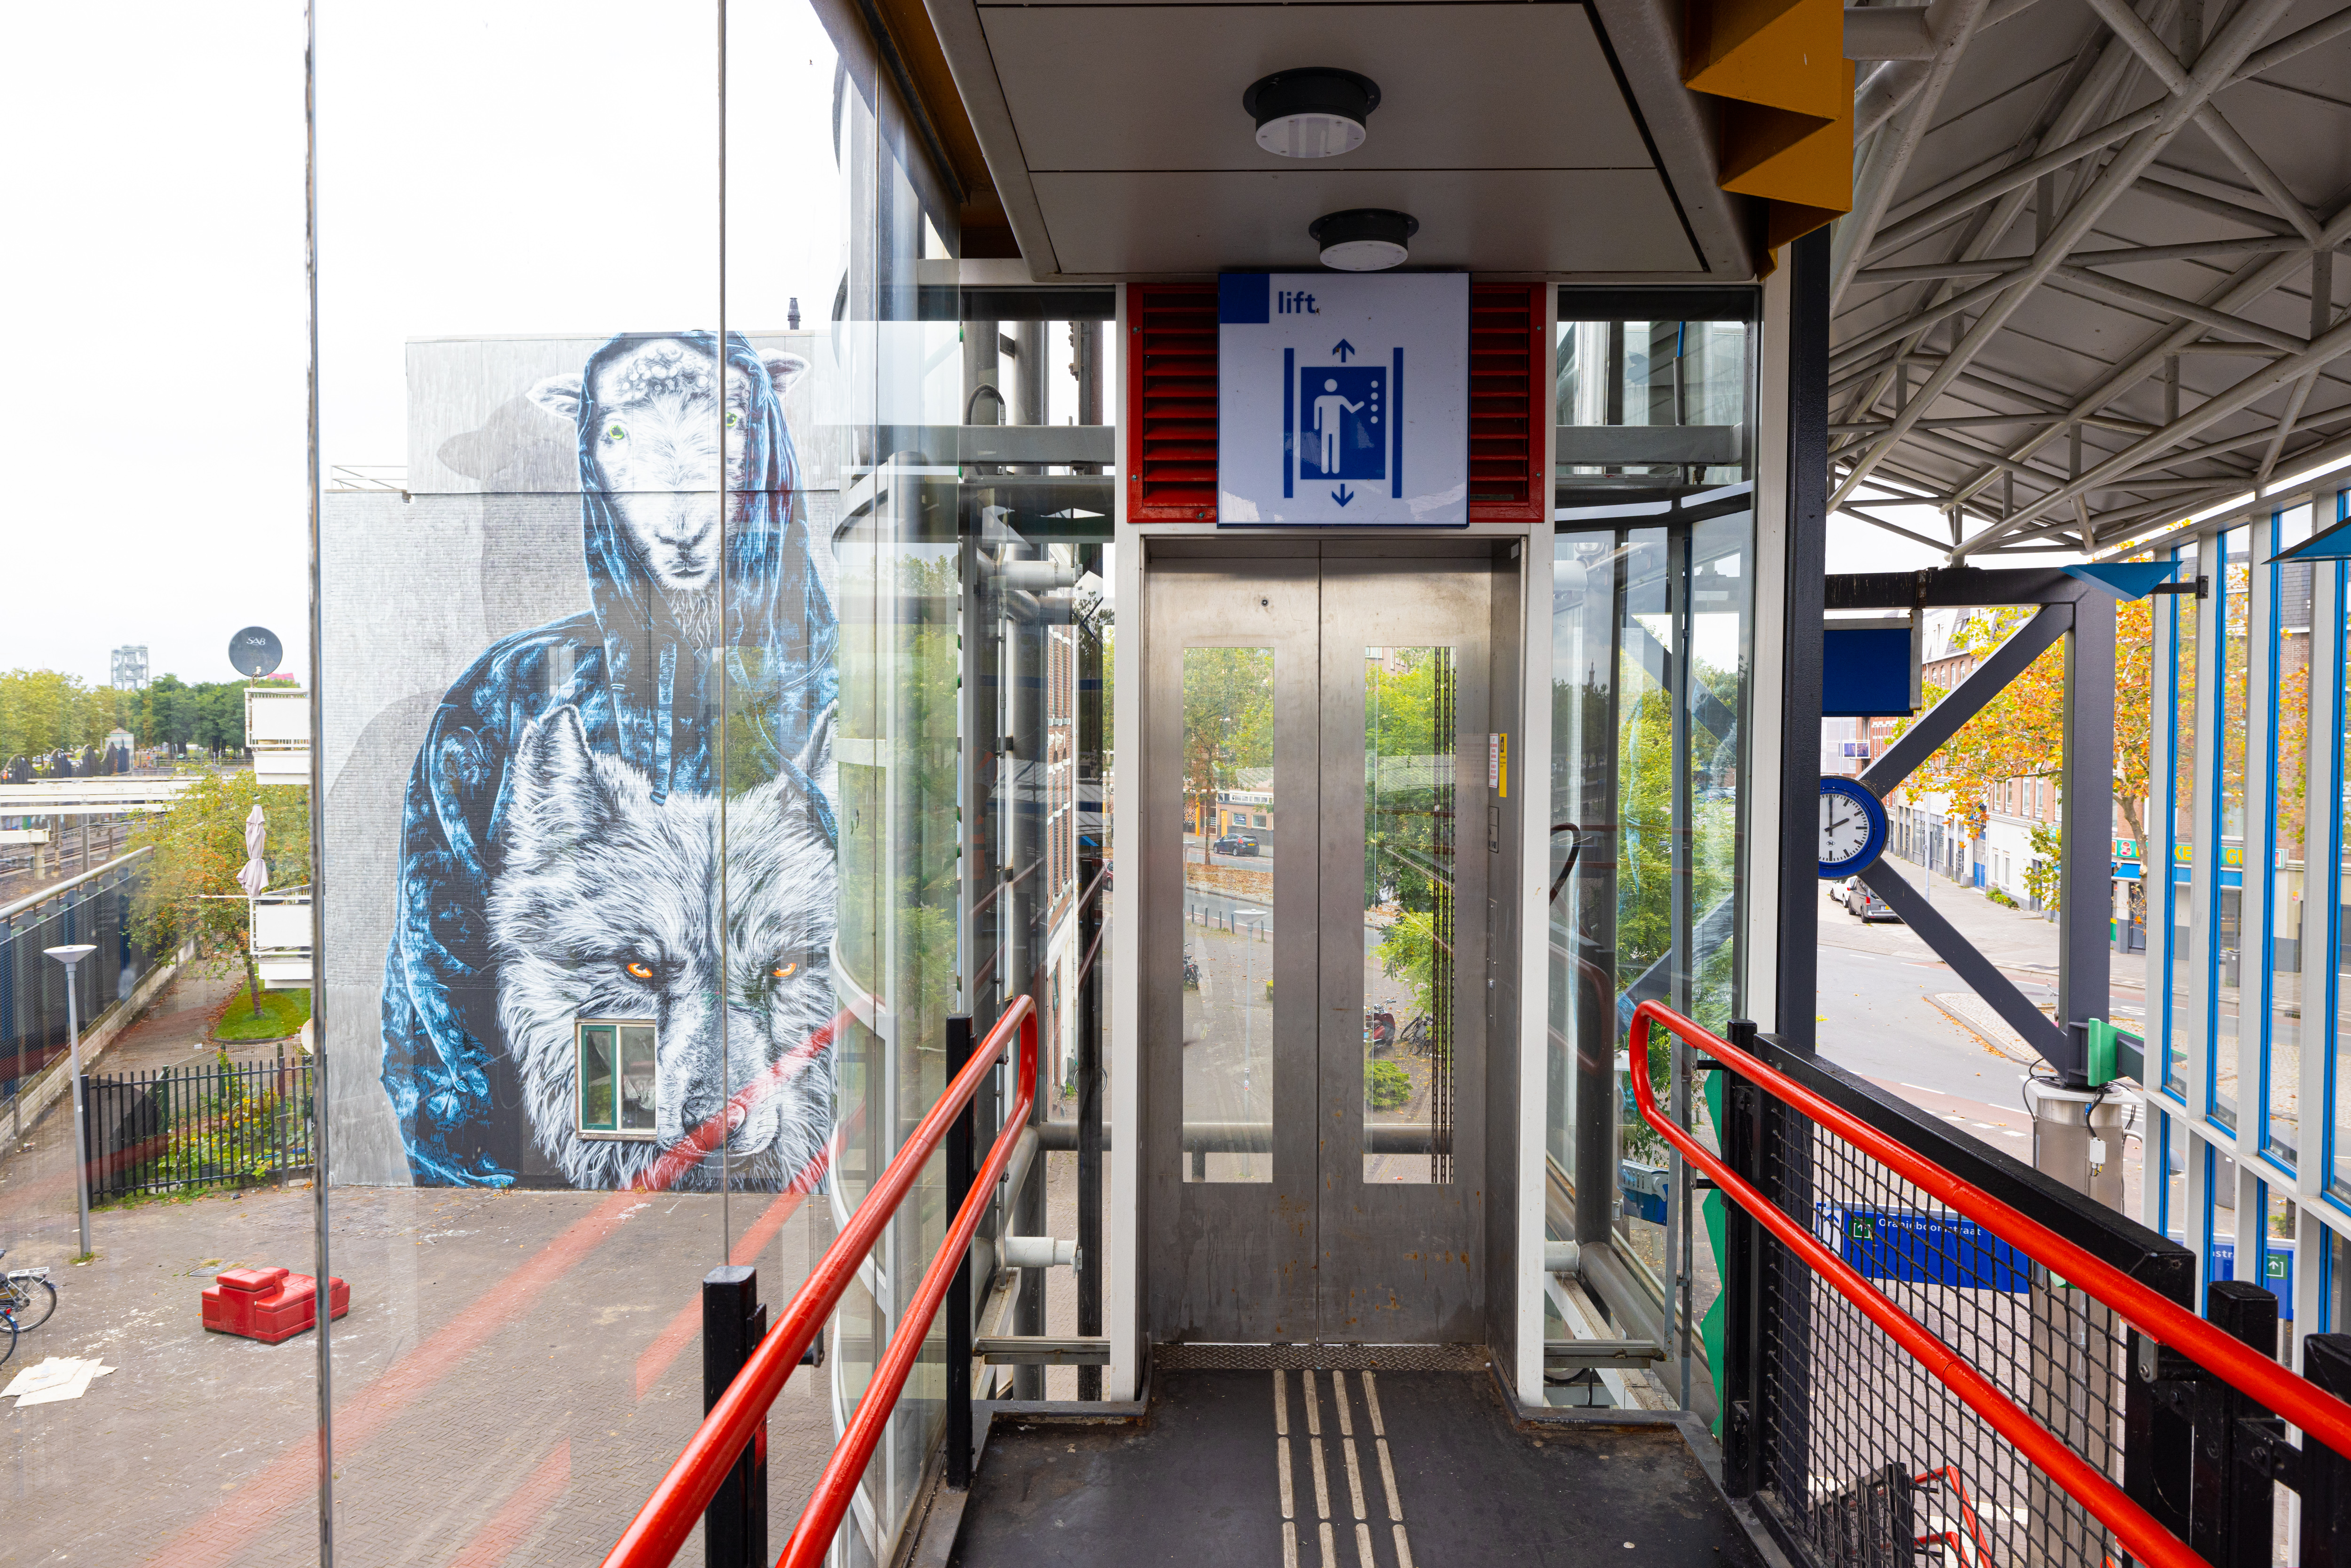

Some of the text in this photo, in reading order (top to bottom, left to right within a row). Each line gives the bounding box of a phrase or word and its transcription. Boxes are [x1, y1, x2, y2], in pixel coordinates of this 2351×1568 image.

[1278, 291, 1316, 314] lift
[246, 637, 266, 646] SAB
[2212, 1250, 2234, 1258] str
